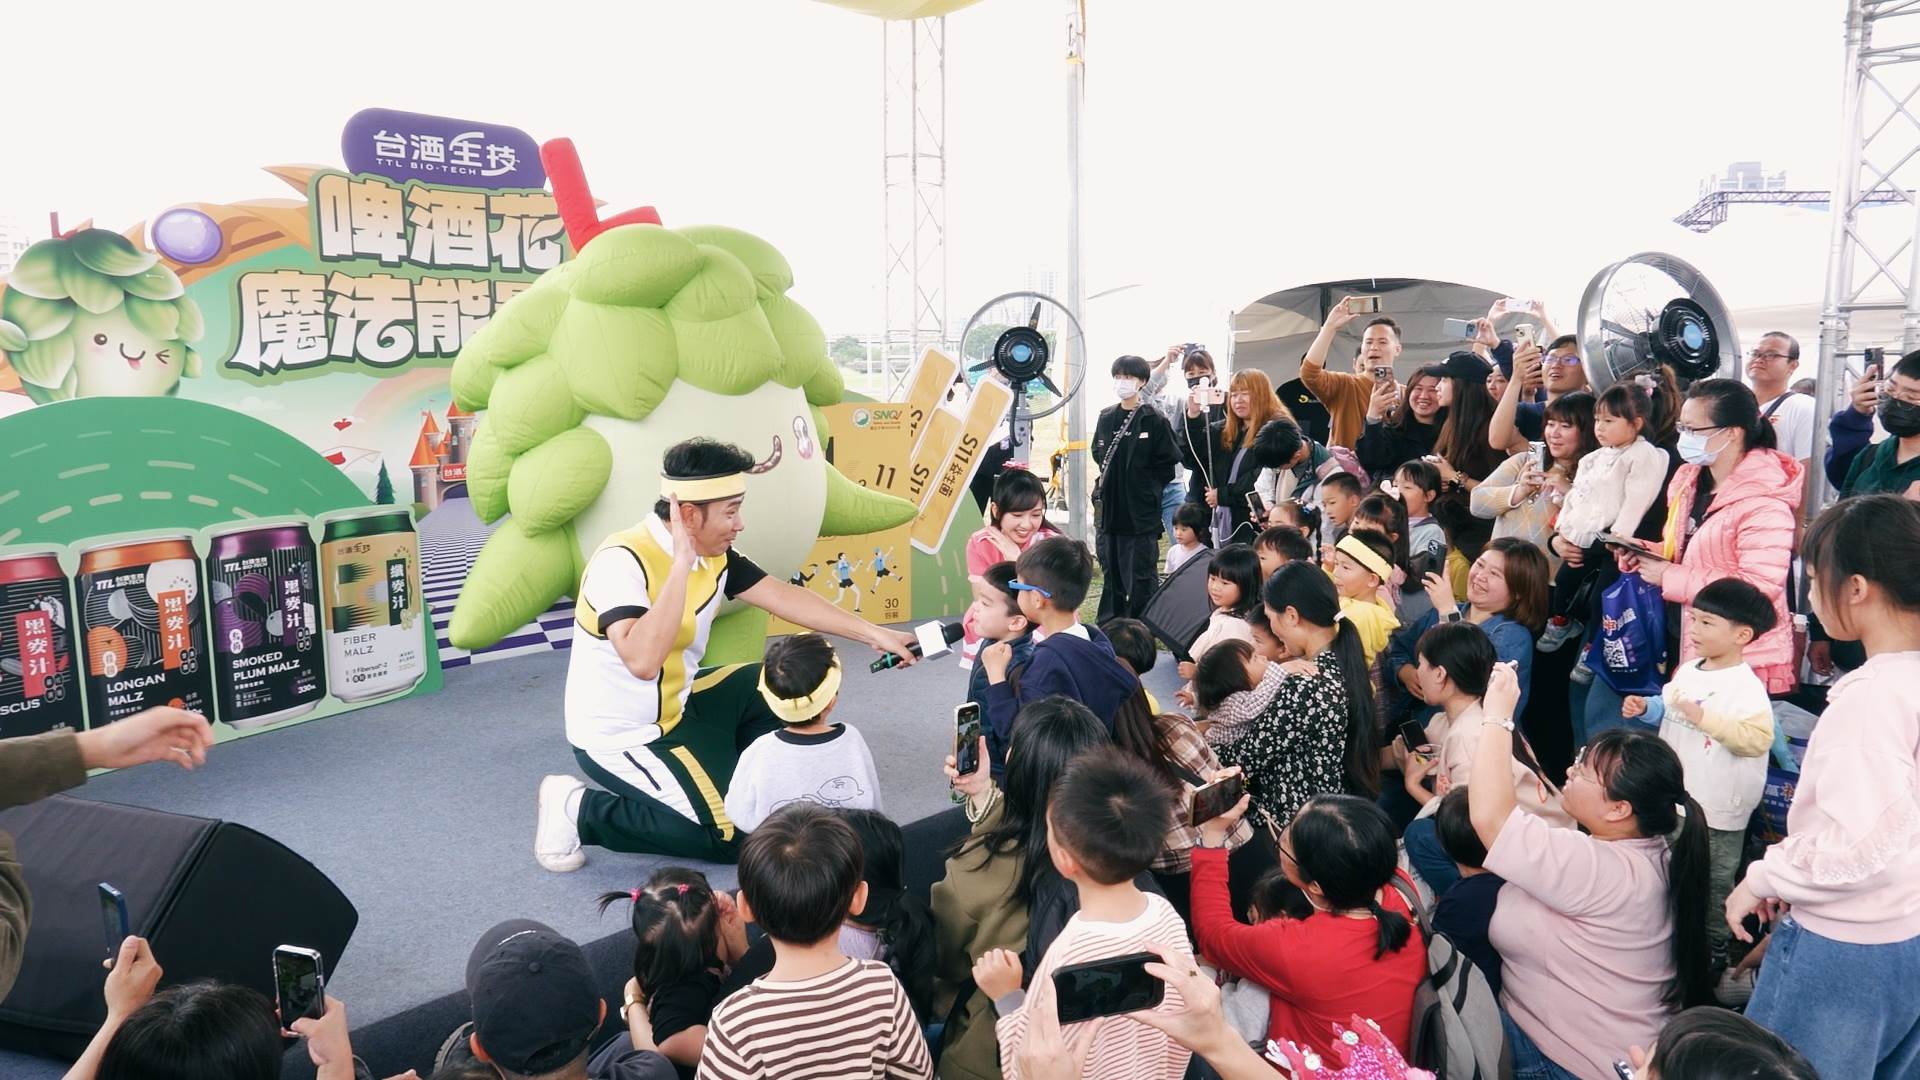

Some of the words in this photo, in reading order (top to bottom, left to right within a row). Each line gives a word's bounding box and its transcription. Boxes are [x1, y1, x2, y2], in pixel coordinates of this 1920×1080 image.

[373, 130, 520, 176] 台酒生技
[376, 158, 402, 167] TTL
[410, 162, 477, 175] BIO-TECH
[317, 174, 565, 271] 啤酒花
[955, 433, 978, 464] S11
[96, 579, 115, 591] TTL
[284, 580, 302, 628] 黑麥汁
[885, 598, 899, 609] 30
[164, 596, 185, 650] 黑麥汁
[24, 618, 50, 676] 黑麥汁
[343, 633, 377, 646] FIBER
[232, 652, 283, 669] SMOKED
[344, 645, 374, 658] MALZ
[233, 665, 266, 681] PLUM
[268, 660, 301, 675] MALZ
[107, 673, 166, 693] LONGAN
[108, 692, 145, 707] MALZ
